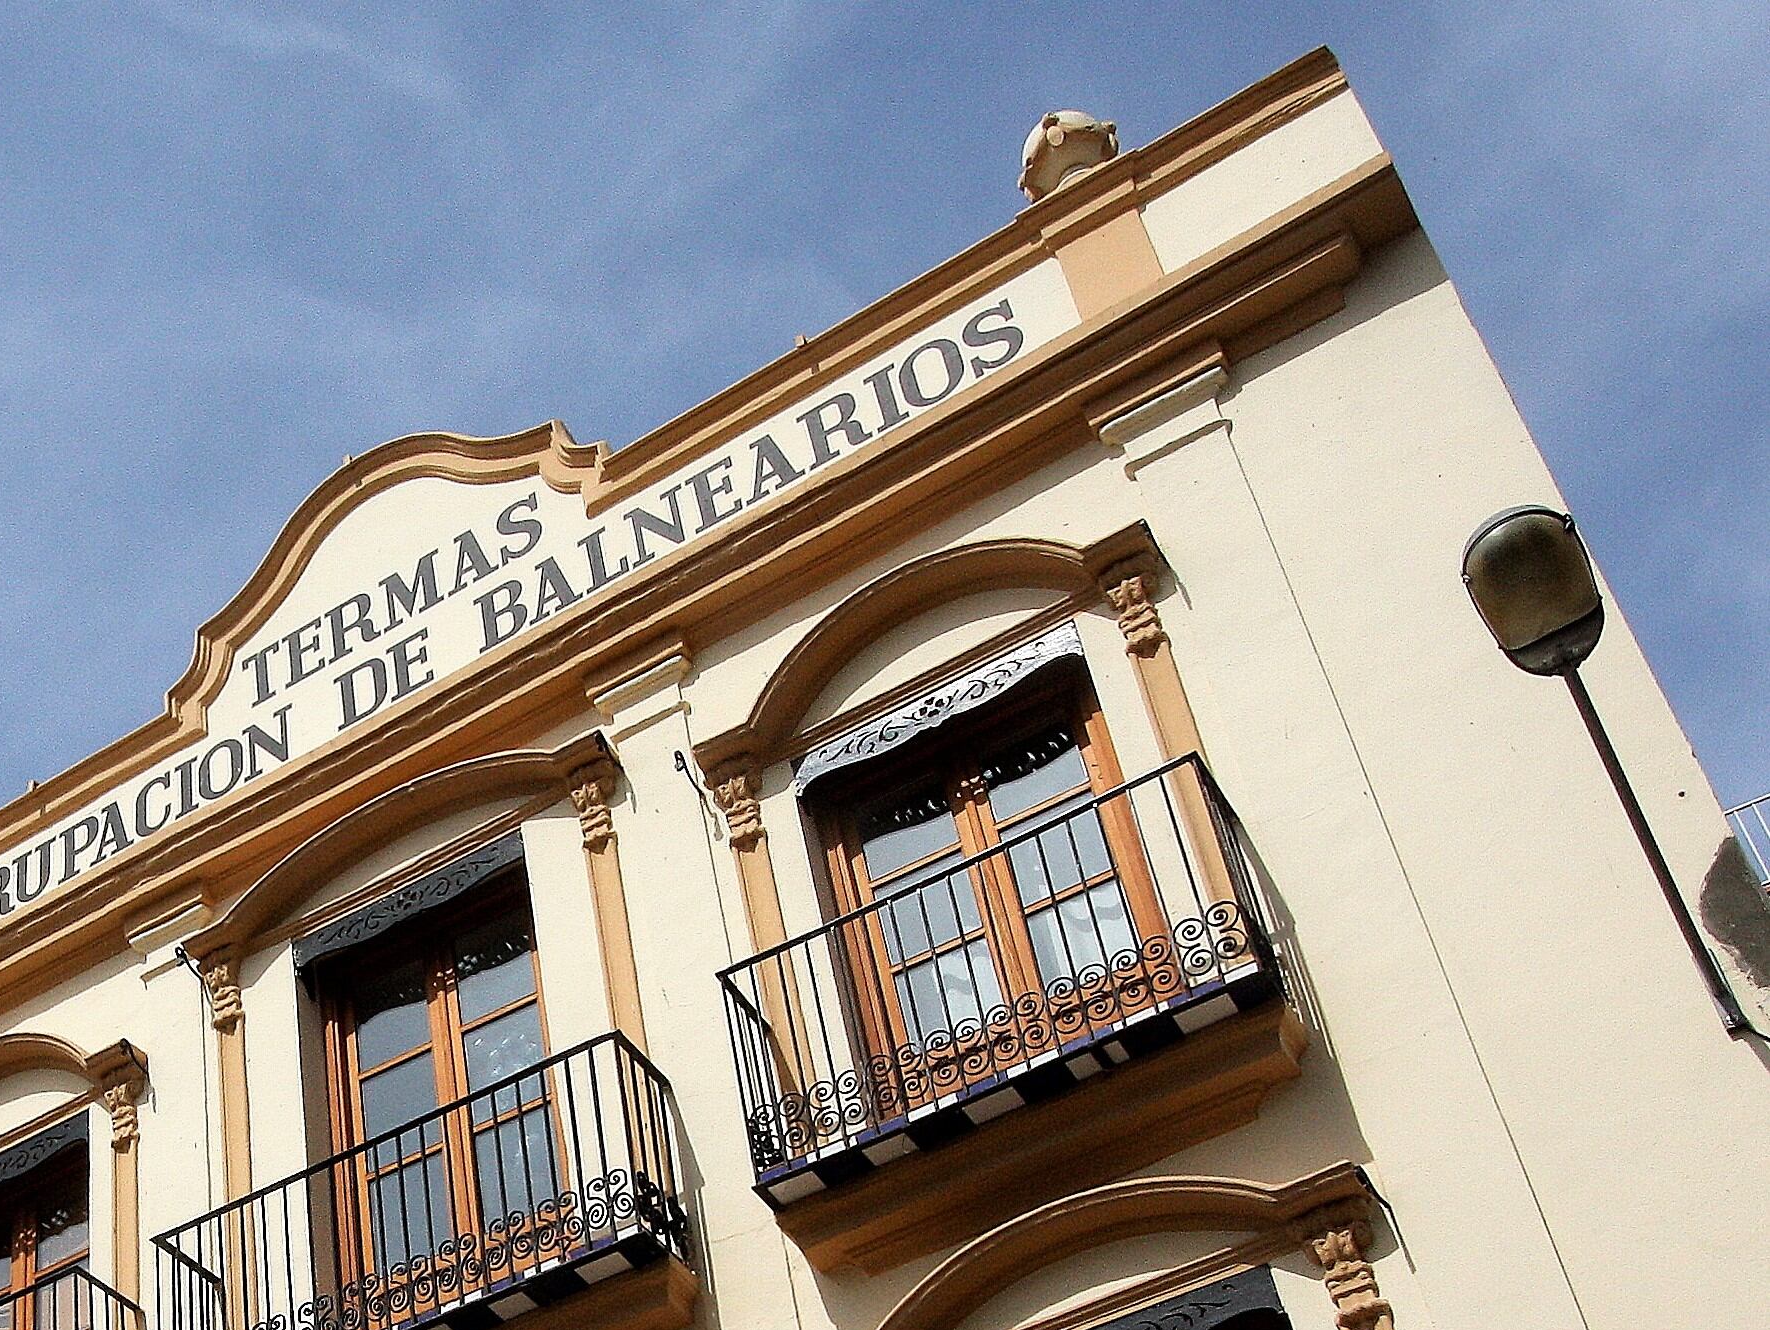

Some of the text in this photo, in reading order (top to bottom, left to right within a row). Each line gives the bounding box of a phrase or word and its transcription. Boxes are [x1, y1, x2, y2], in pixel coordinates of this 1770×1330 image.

[242, 493, 543, 708] TERMAS
[333, 627, 436, 731] DE
[473, 299, 1024, 654] BALNEARIOS
